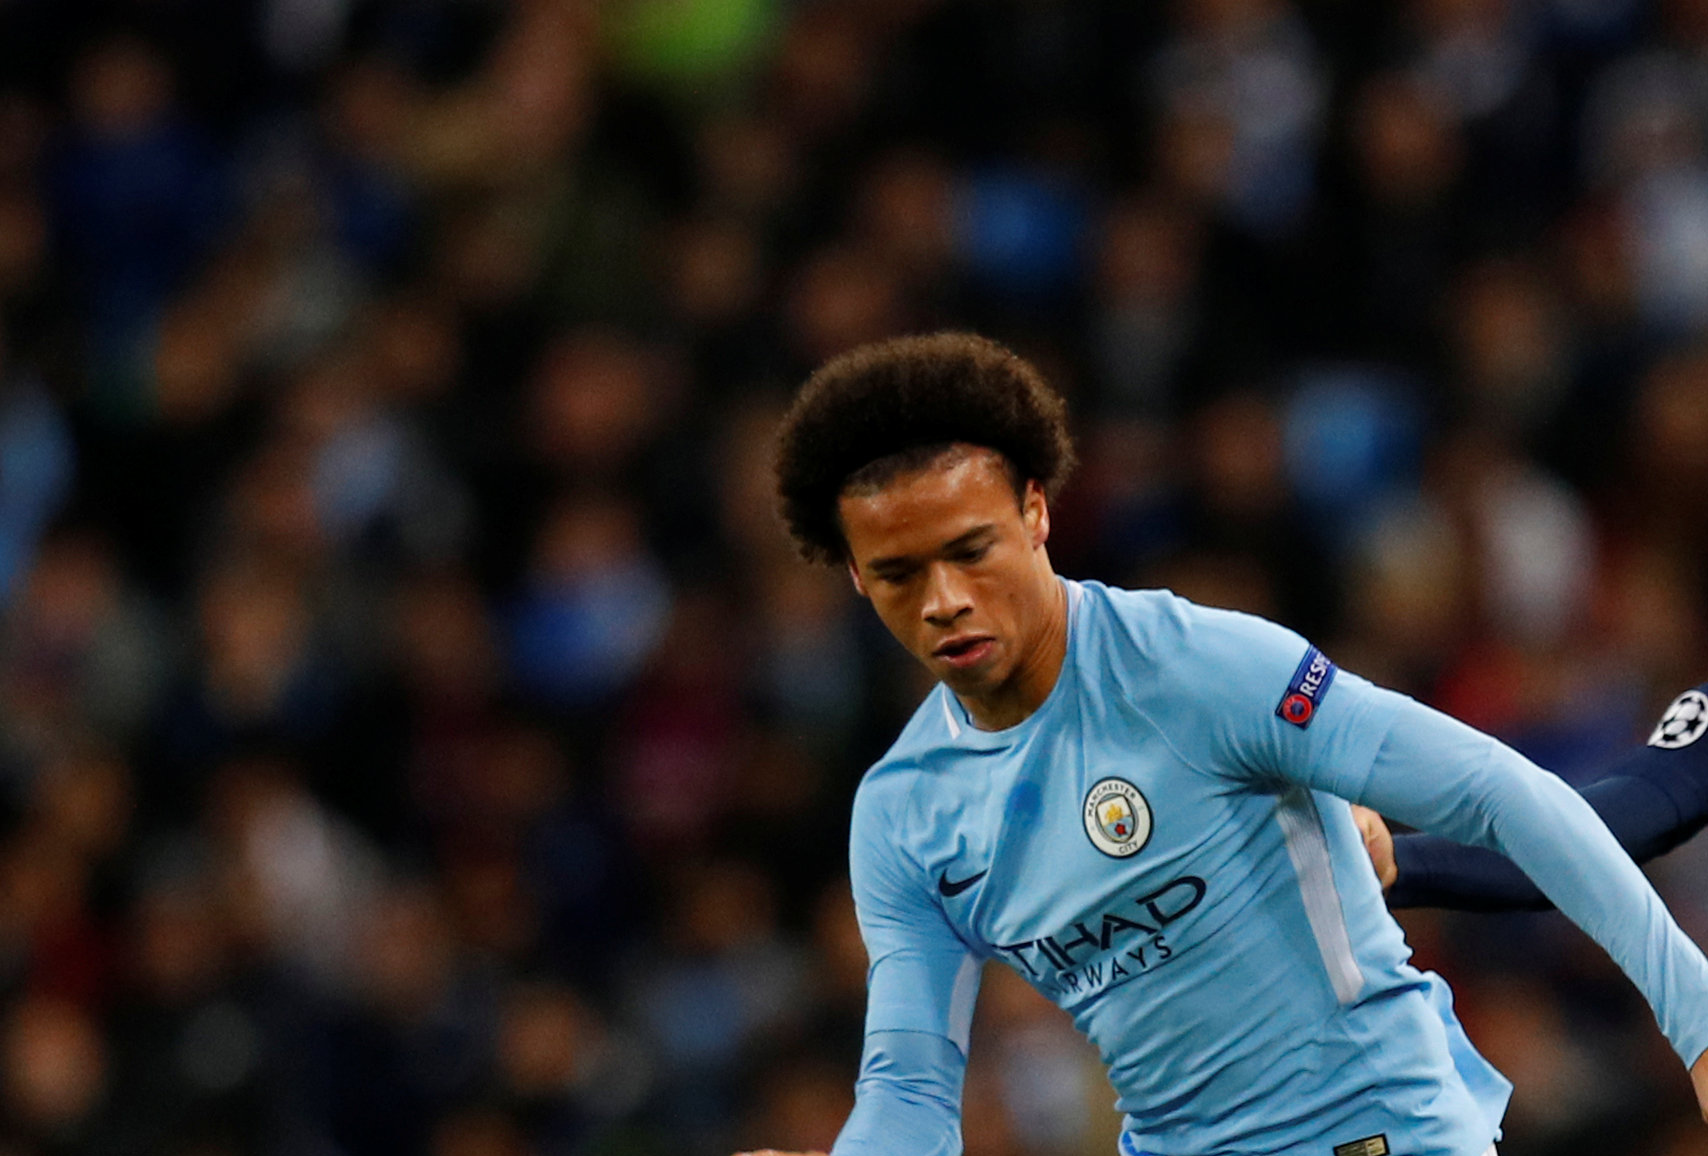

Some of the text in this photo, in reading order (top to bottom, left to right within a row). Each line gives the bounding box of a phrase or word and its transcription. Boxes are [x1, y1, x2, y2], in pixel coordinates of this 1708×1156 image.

[1087, 782, 1137, 818] MANCHESTER
[1118, 840, 1138, 855] CITY
[992, 875, 1208, 977] TIHAD
